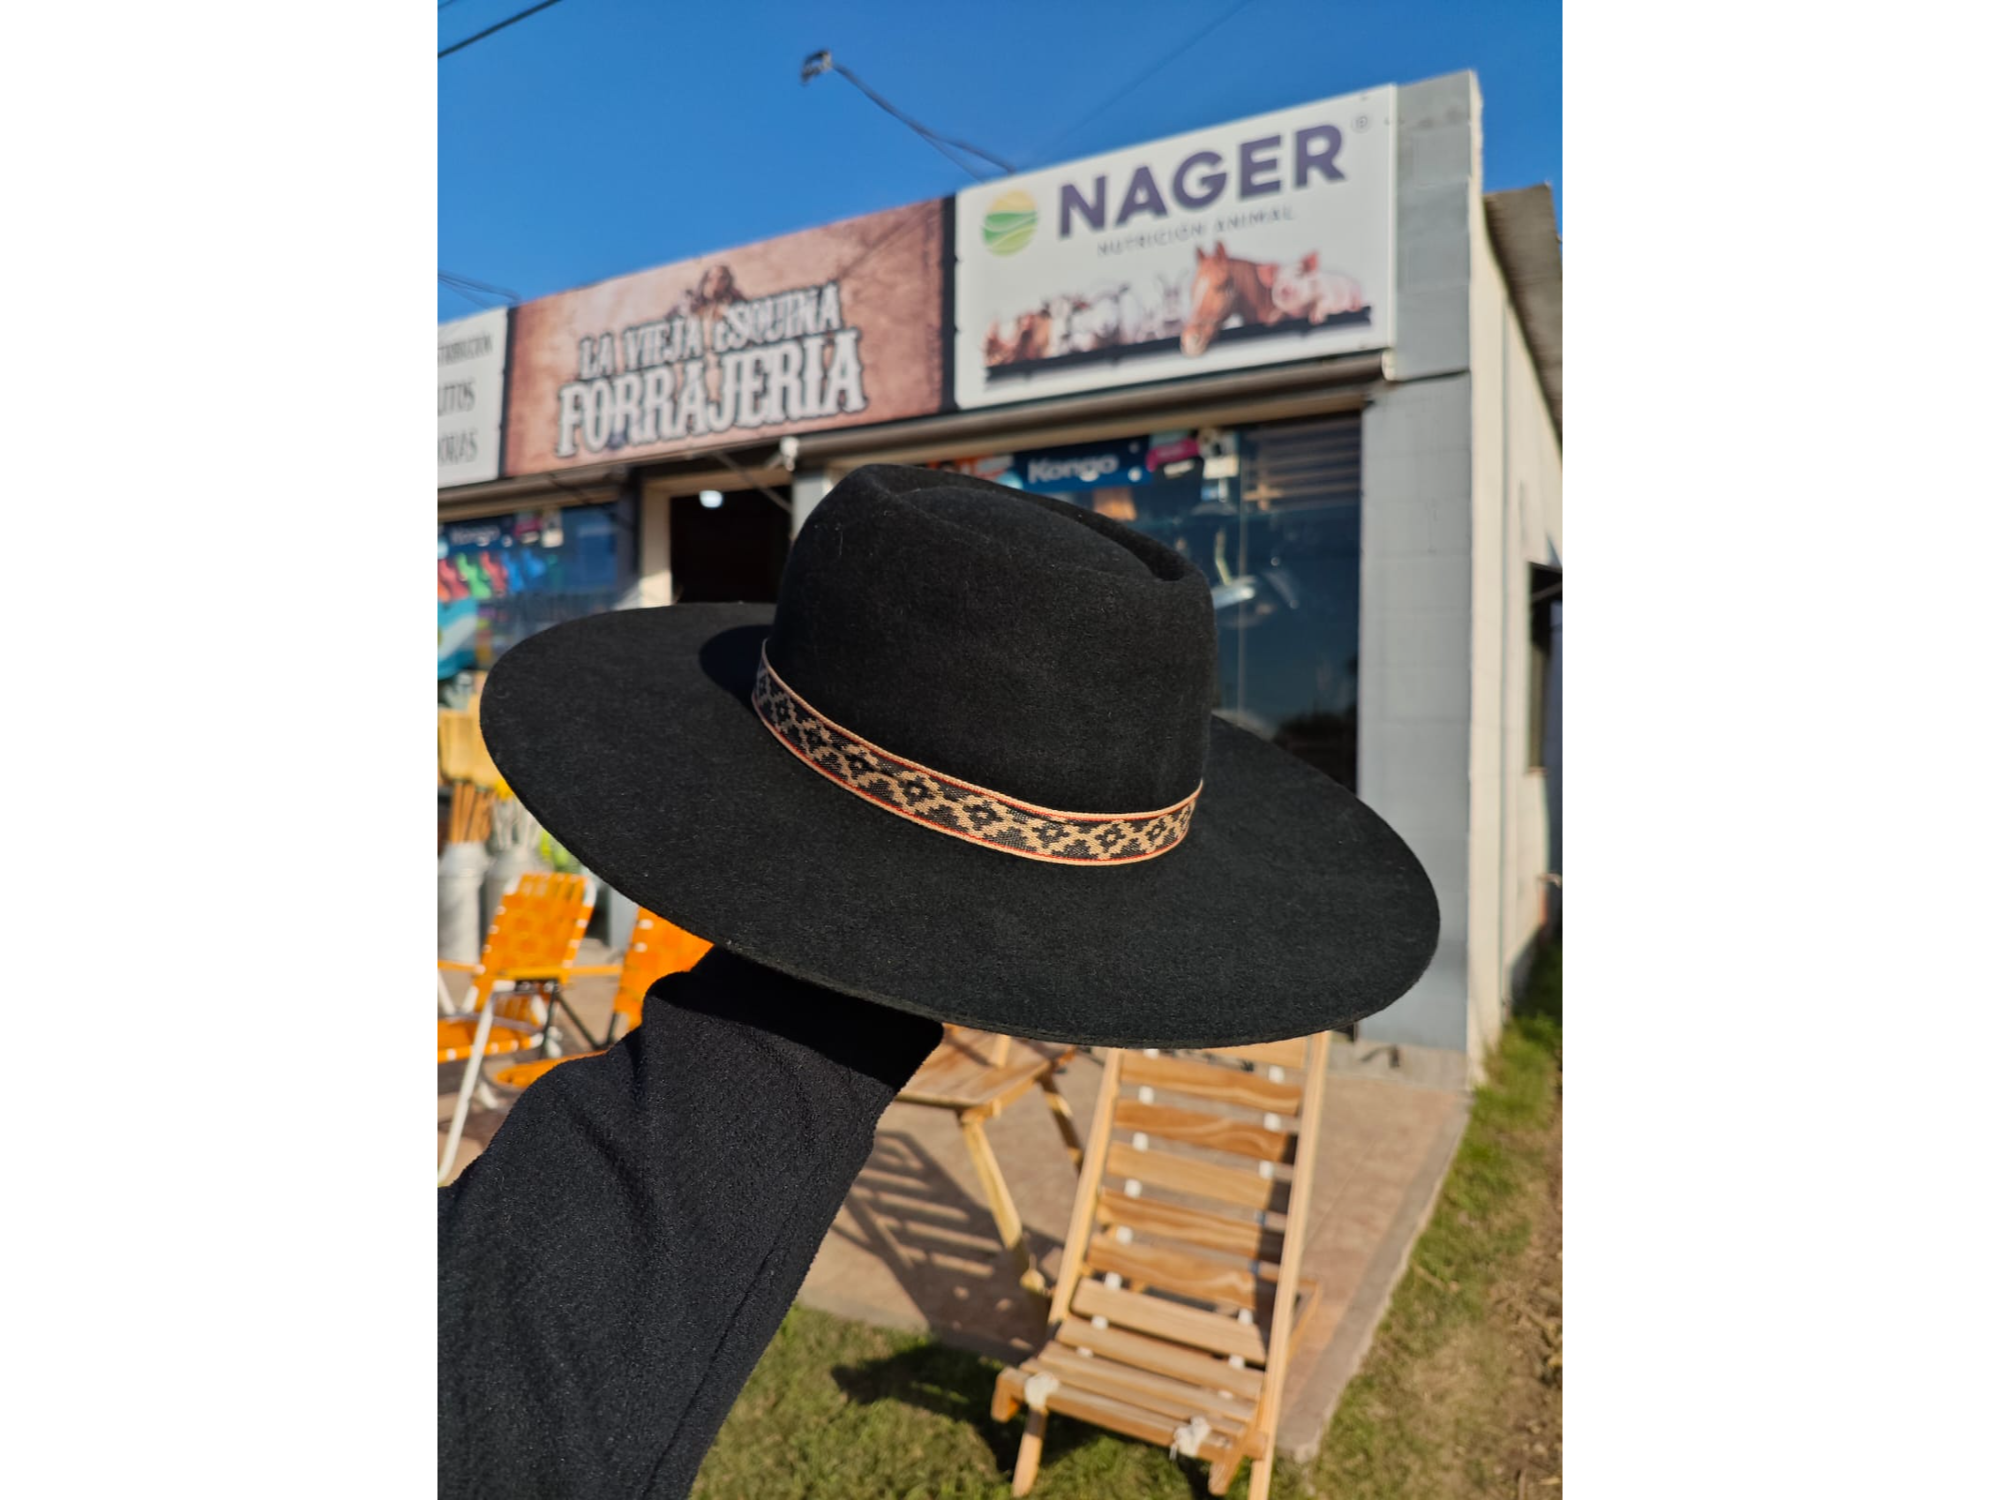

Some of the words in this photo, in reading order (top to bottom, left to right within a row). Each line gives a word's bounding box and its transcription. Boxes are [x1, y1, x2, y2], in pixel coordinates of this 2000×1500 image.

[1058, 124, 1346, 240] NAGER
[1216, 205, 1295, 232] ANIMAL
[579, 332, 615, 380] LA
[623, 314, 703, 371] VIEJA
[1027, 454, 1119, 485] Kongo
